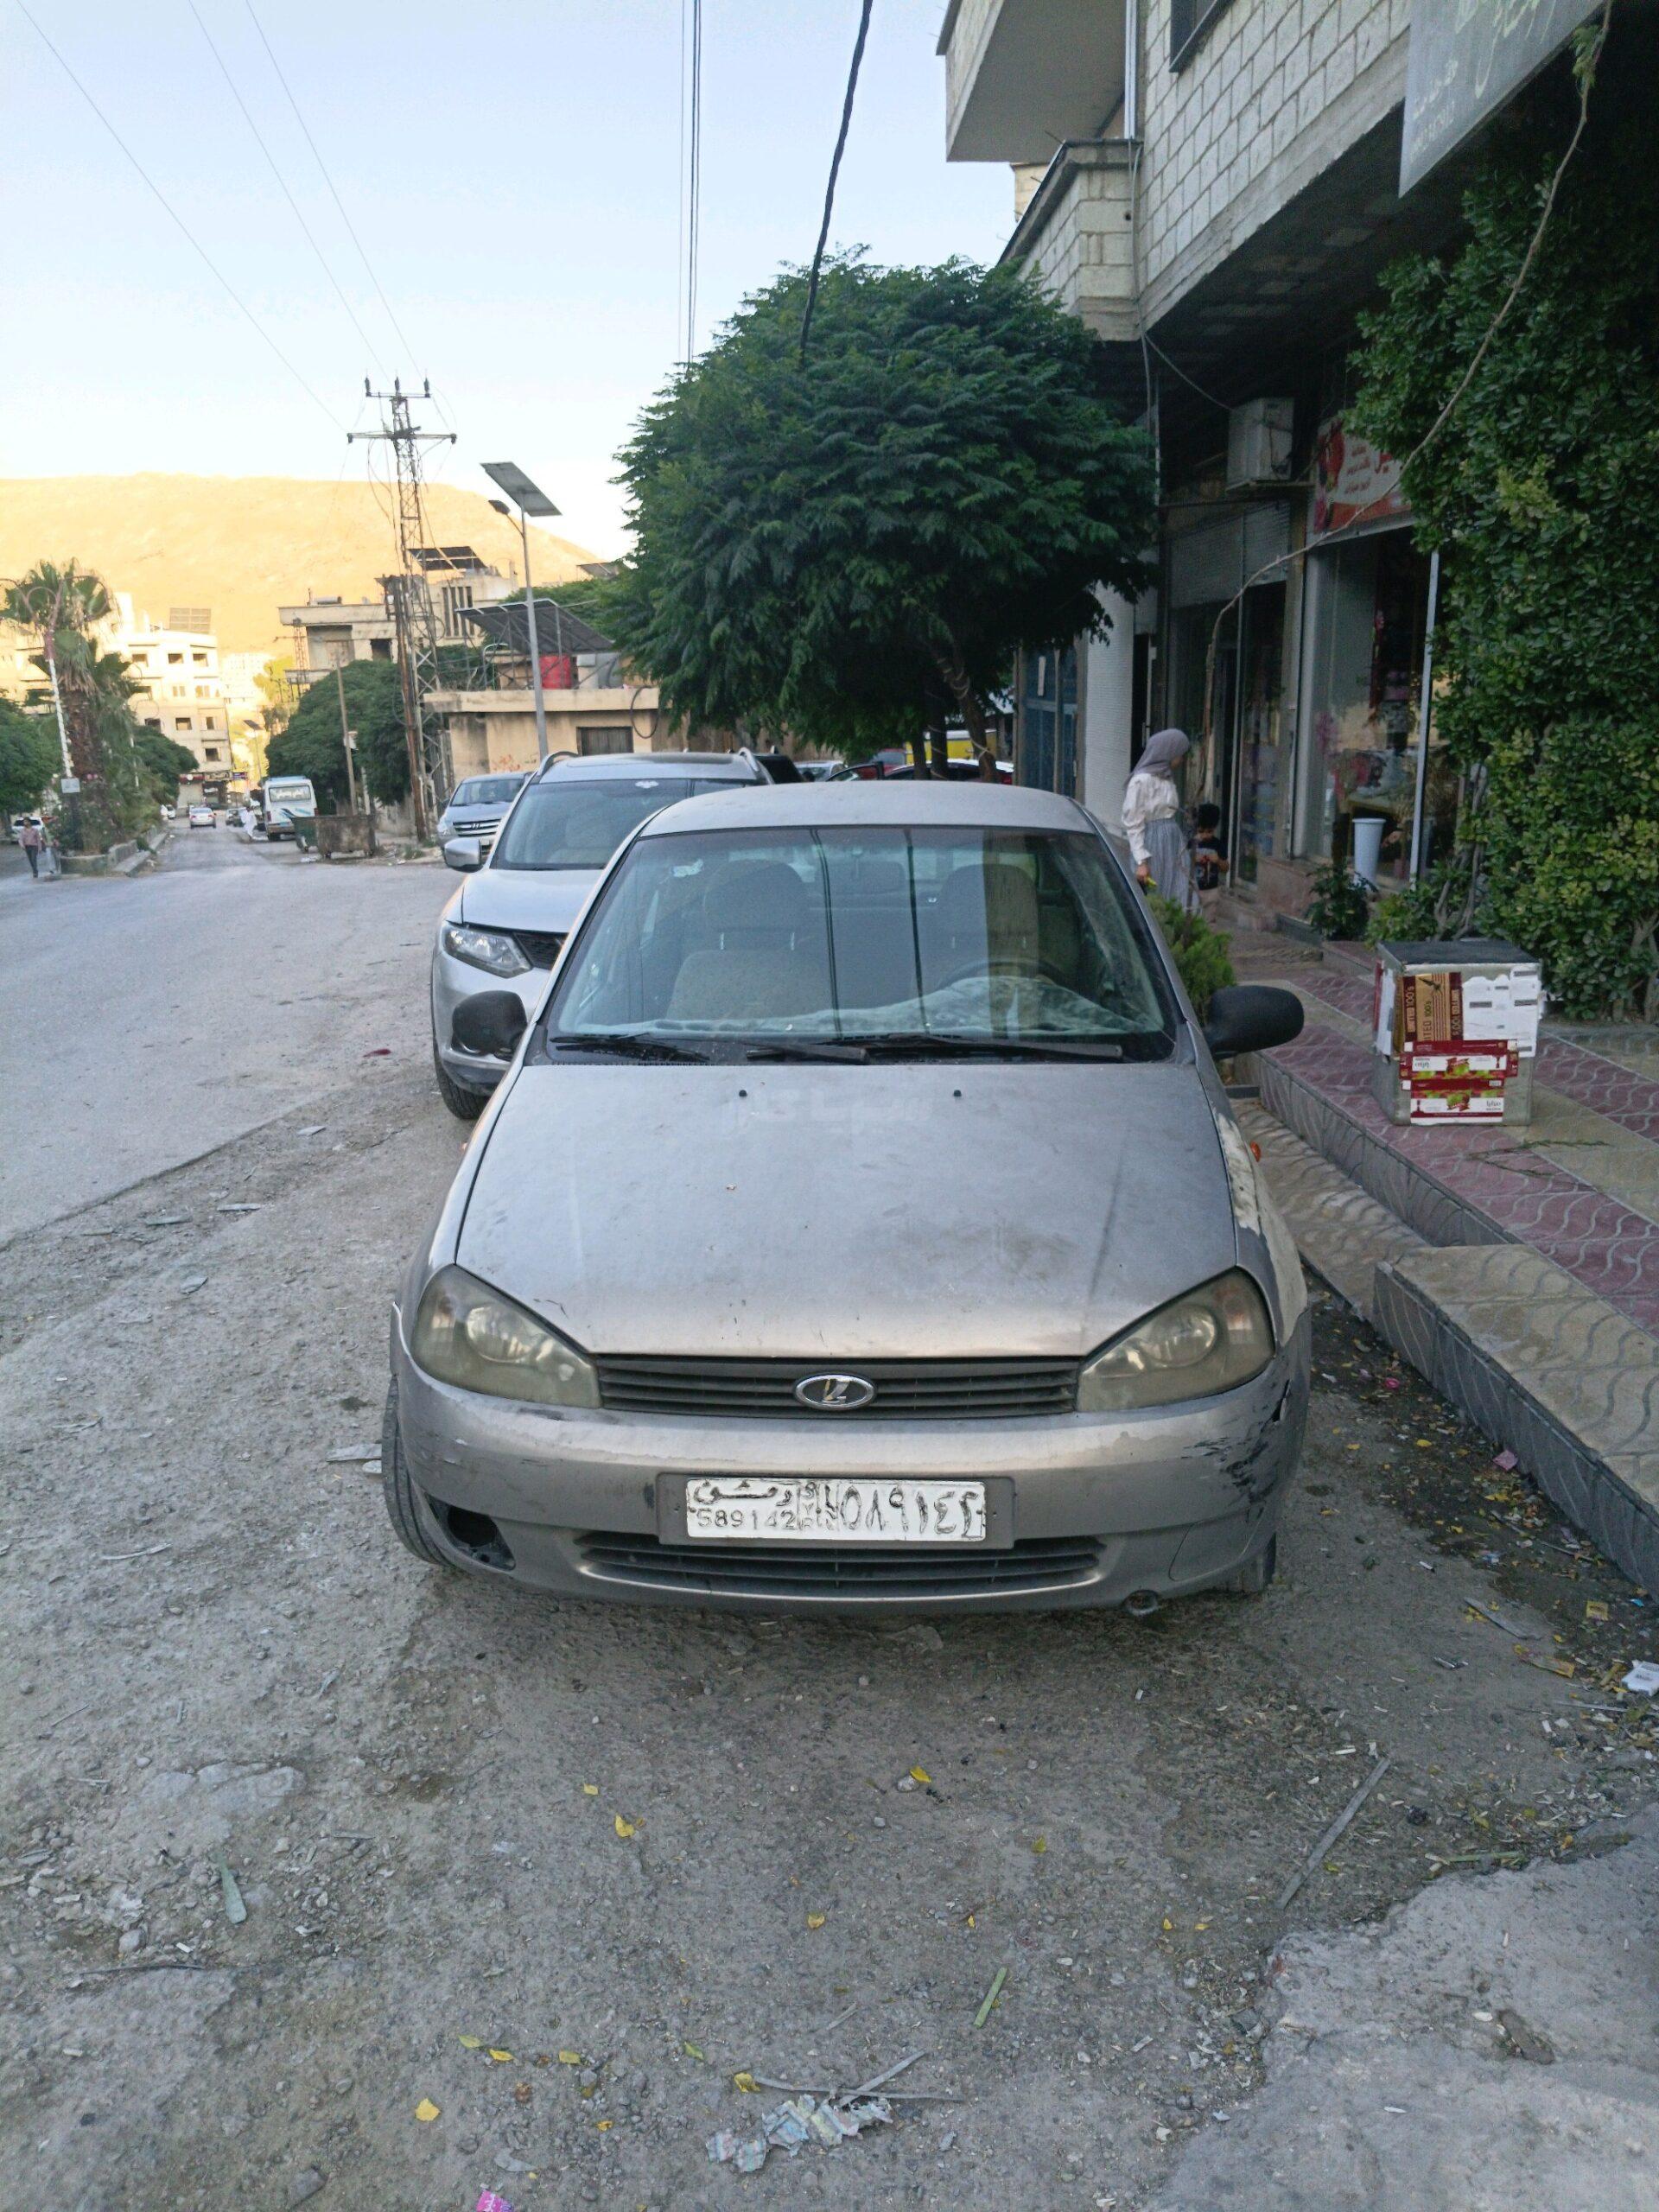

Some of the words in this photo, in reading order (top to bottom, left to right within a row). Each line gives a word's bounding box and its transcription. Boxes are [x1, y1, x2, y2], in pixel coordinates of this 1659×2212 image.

[1423, 1020, 1432, 1040] ITED
[696, 1508, 797, 1529] 589142
[840, 1485, 978, 1537] ٥٨٩١٤٢
